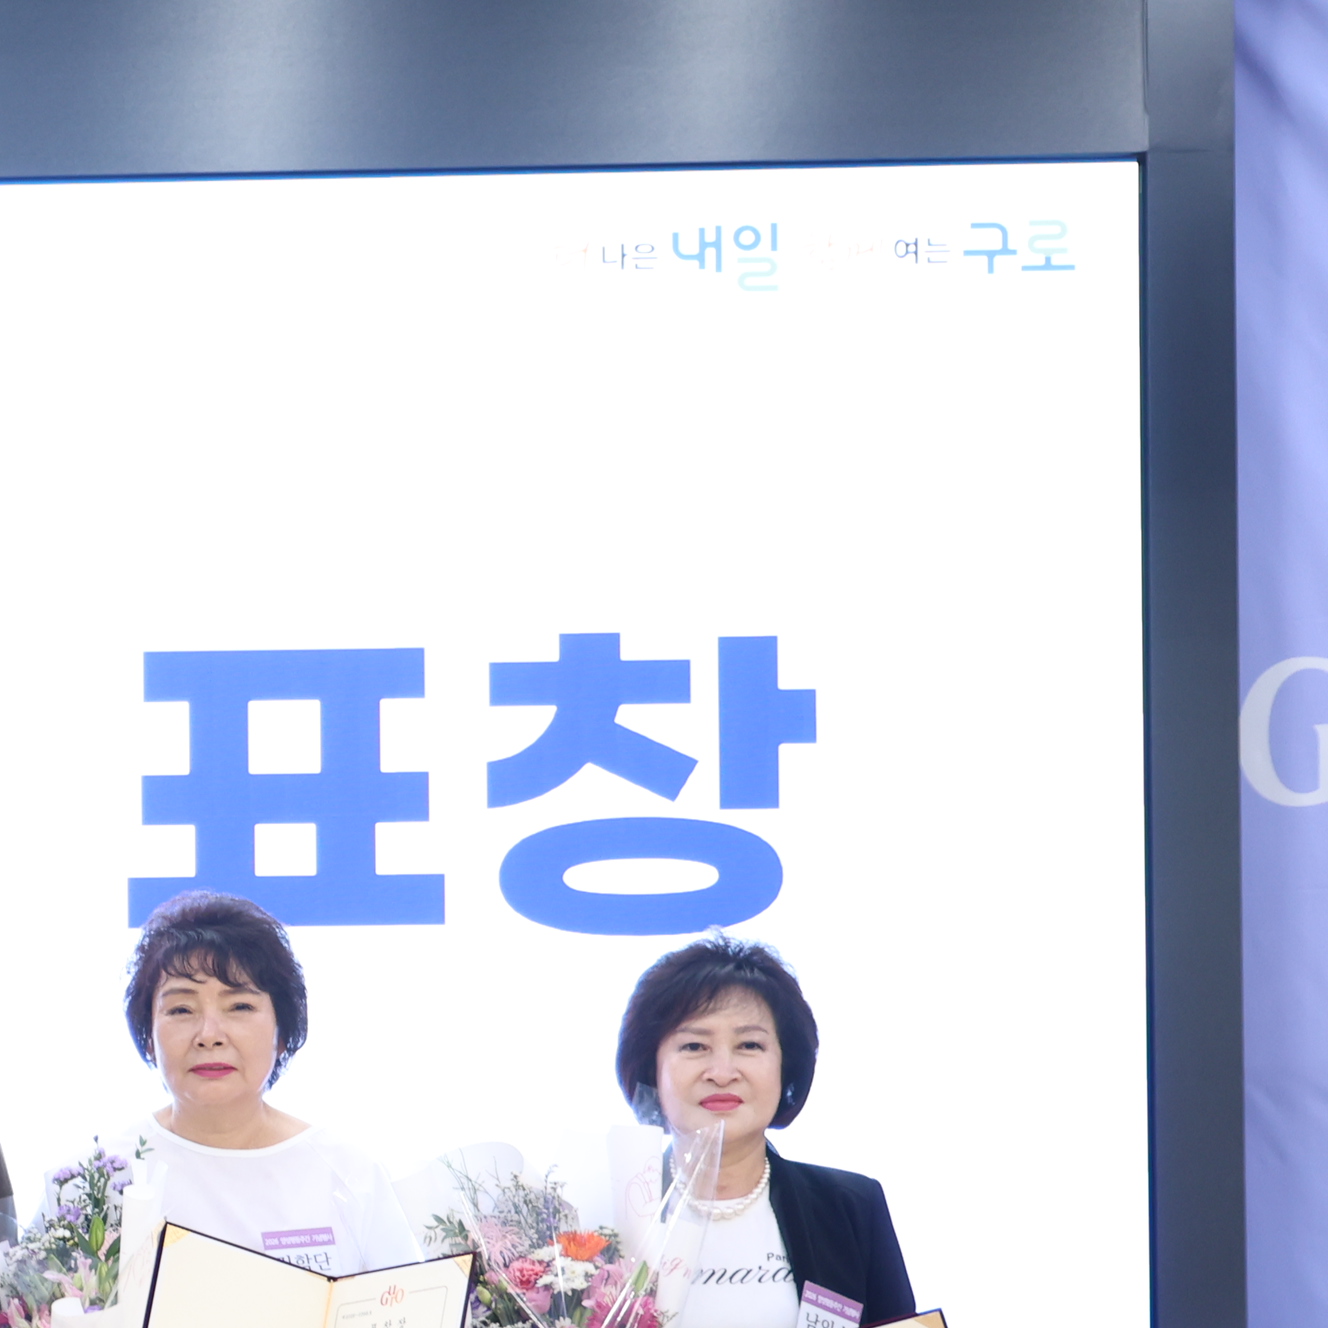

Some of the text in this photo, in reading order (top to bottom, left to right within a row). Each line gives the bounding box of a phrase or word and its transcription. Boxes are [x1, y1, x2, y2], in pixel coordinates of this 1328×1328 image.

[602, 243, 658, 270] 나은
[672, 222, 779, 292] 내일
[894, 237, 950, 264] 여는
[963, 219, 1076, 272] 구로
[128, 632, 817, 937] 표창
